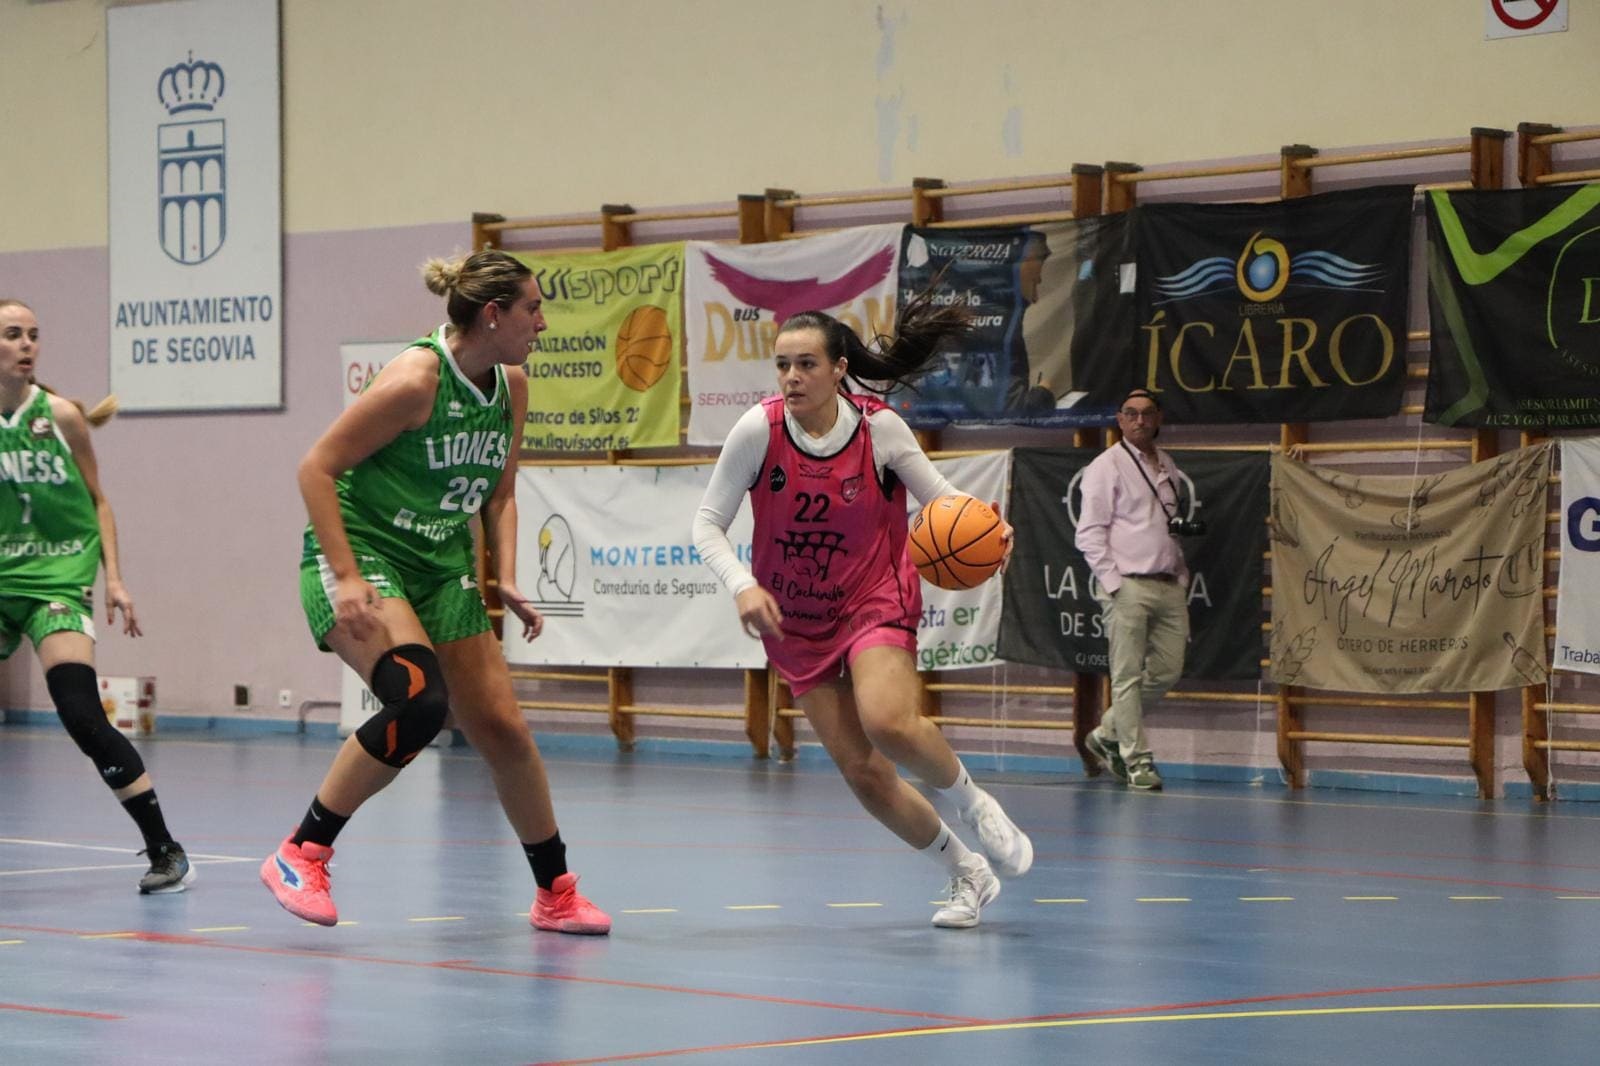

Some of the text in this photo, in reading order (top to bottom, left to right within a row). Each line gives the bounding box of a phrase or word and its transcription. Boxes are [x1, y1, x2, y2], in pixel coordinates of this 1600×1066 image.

[115, 295, 273, 328] AYUNTAMIENTO
[733, 308, 760, 322] BUS
[132, 335, 256, 364] DE SEGOVIA
[1141, 310, 1394, 394] ÍCARO
[347, 362, 383, 394] GA
[568, 407, 586, 424] de
[588, 407, 621, 425] Silos
[425, 430, 513, 470] LIONES
[439, 476, 489, 514] 26
[794, 492, 831, 523] 22
[653, 579, 668, 595] de
[671, 578, 717, 599] Seguros
[1044, 565, 1078, 600] LA
[1061, 612, 1084, 636] DE
[1337, 636, 1468, 653] OTERO DE HERREROS
